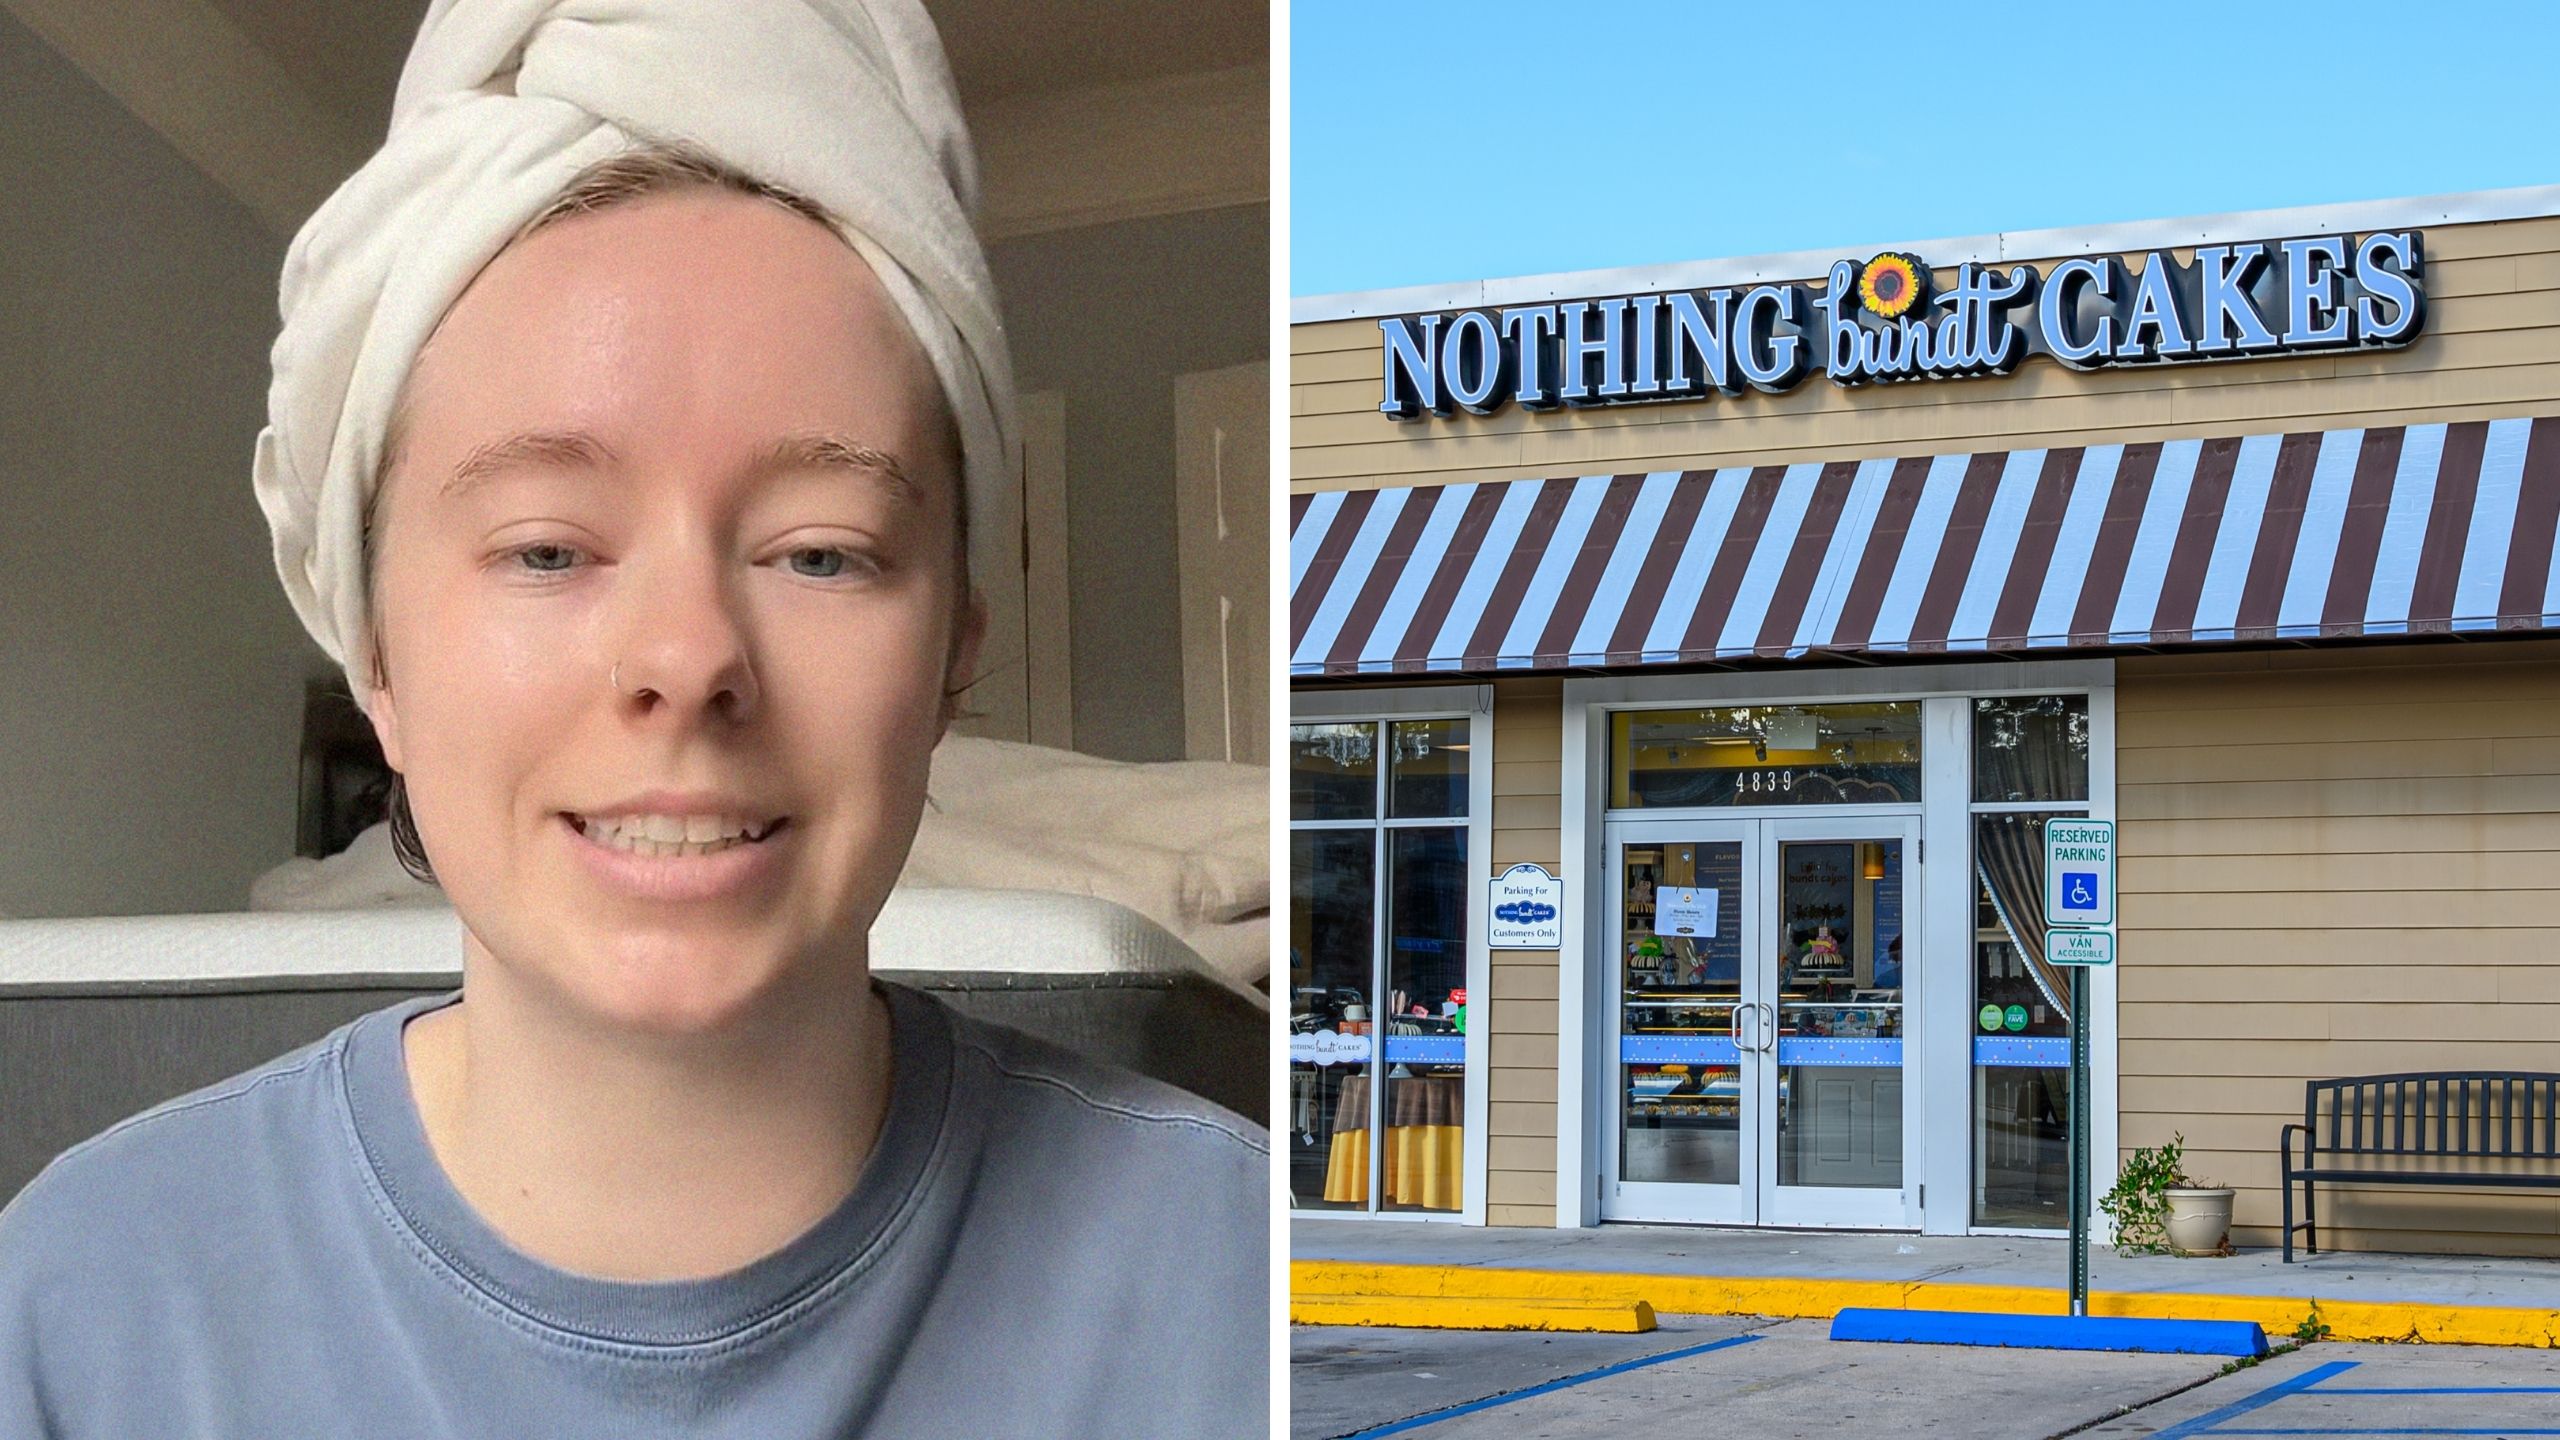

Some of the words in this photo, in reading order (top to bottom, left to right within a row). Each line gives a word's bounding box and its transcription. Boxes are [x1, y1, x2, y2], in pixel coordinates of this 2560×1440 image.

[1378, 284, 1799, 413] NOTHING
[1814, 258, 2026, 379] bundt
[2039, 231, 2420, 359] CAKES
[1735, 770, 1791, 793] 4839
[2051, 829, 2110, 844] RESERVED
[2055, 847, 2106, 862] PARKING
[1504, 886, 1534, 897] Parking
[1535, 886, 1548, 895] For
[1493, 928, 1535, 938] Customers
[1536, 928, 1557, 940] Only
[2069, 937, 2092, 948] VAN
[2057, 949, 2104, 958] ACCESSIBLE
